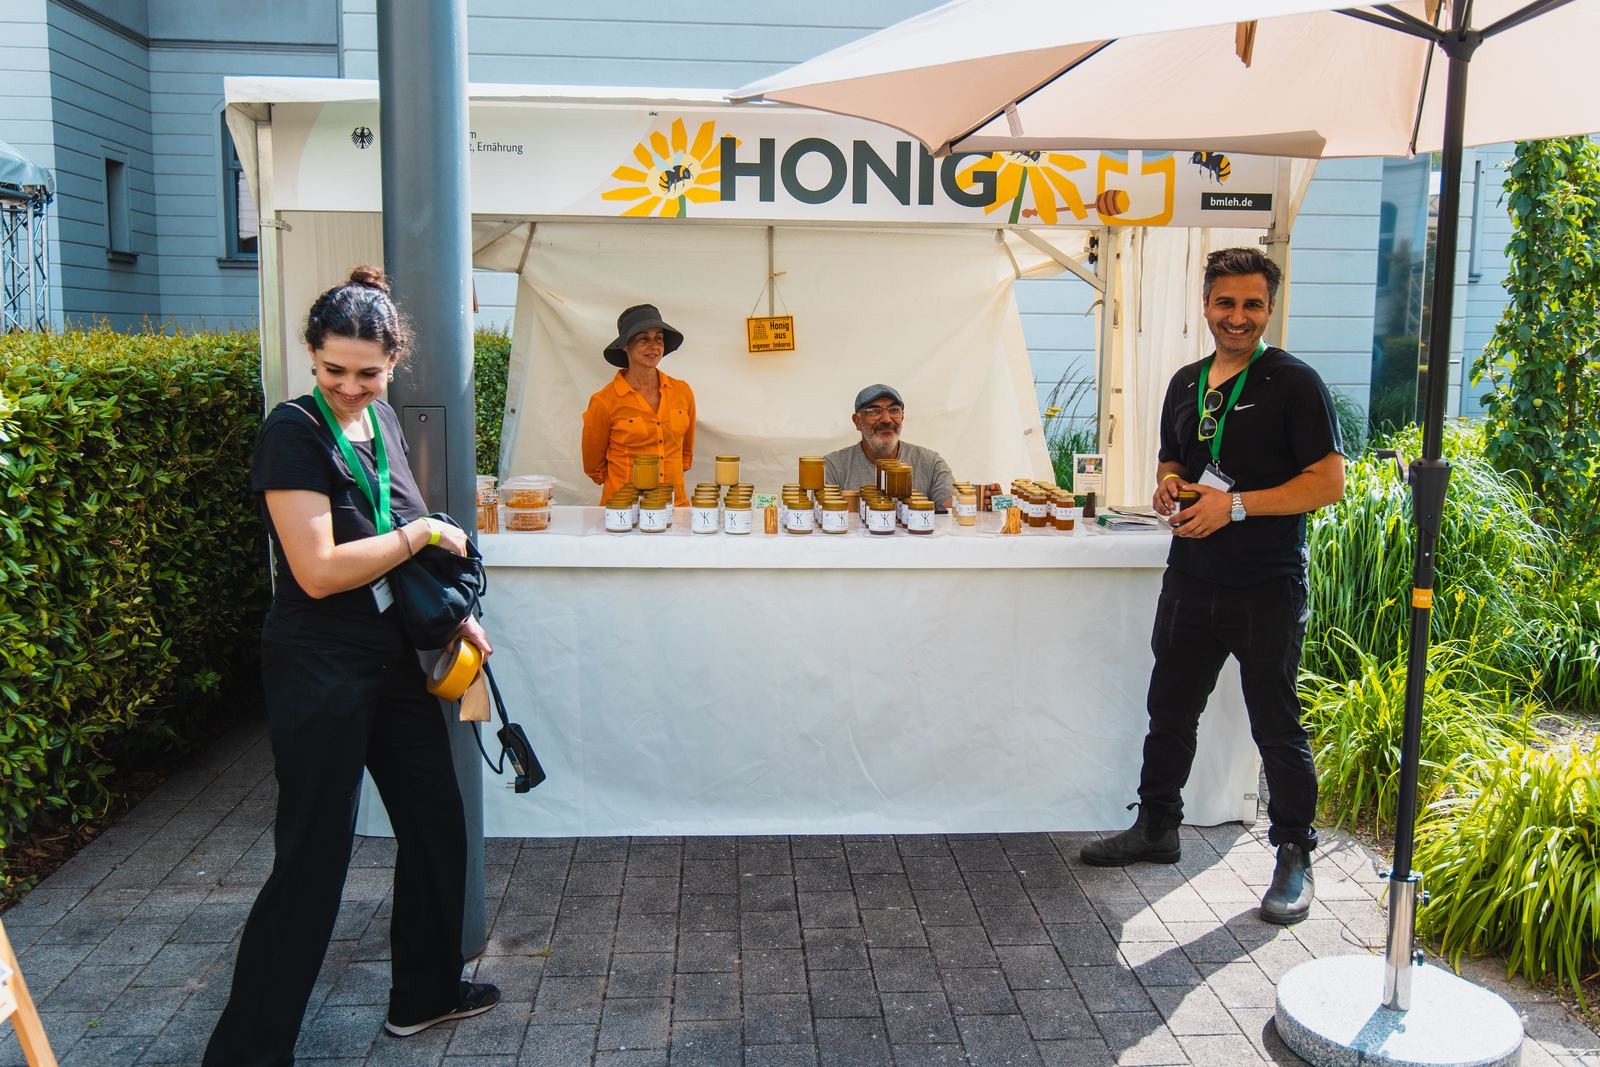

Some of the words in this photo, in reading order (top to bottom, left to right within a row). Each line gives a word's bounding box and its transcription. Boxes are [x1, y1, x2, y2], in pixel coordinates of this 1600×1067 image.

[477, 141, 523, 154] Ernährung
[720, 137, 998, 208] HONIG
[1210, 196, 1253, 207] bmleh.de
[770, 321, 790, 331] Honig
